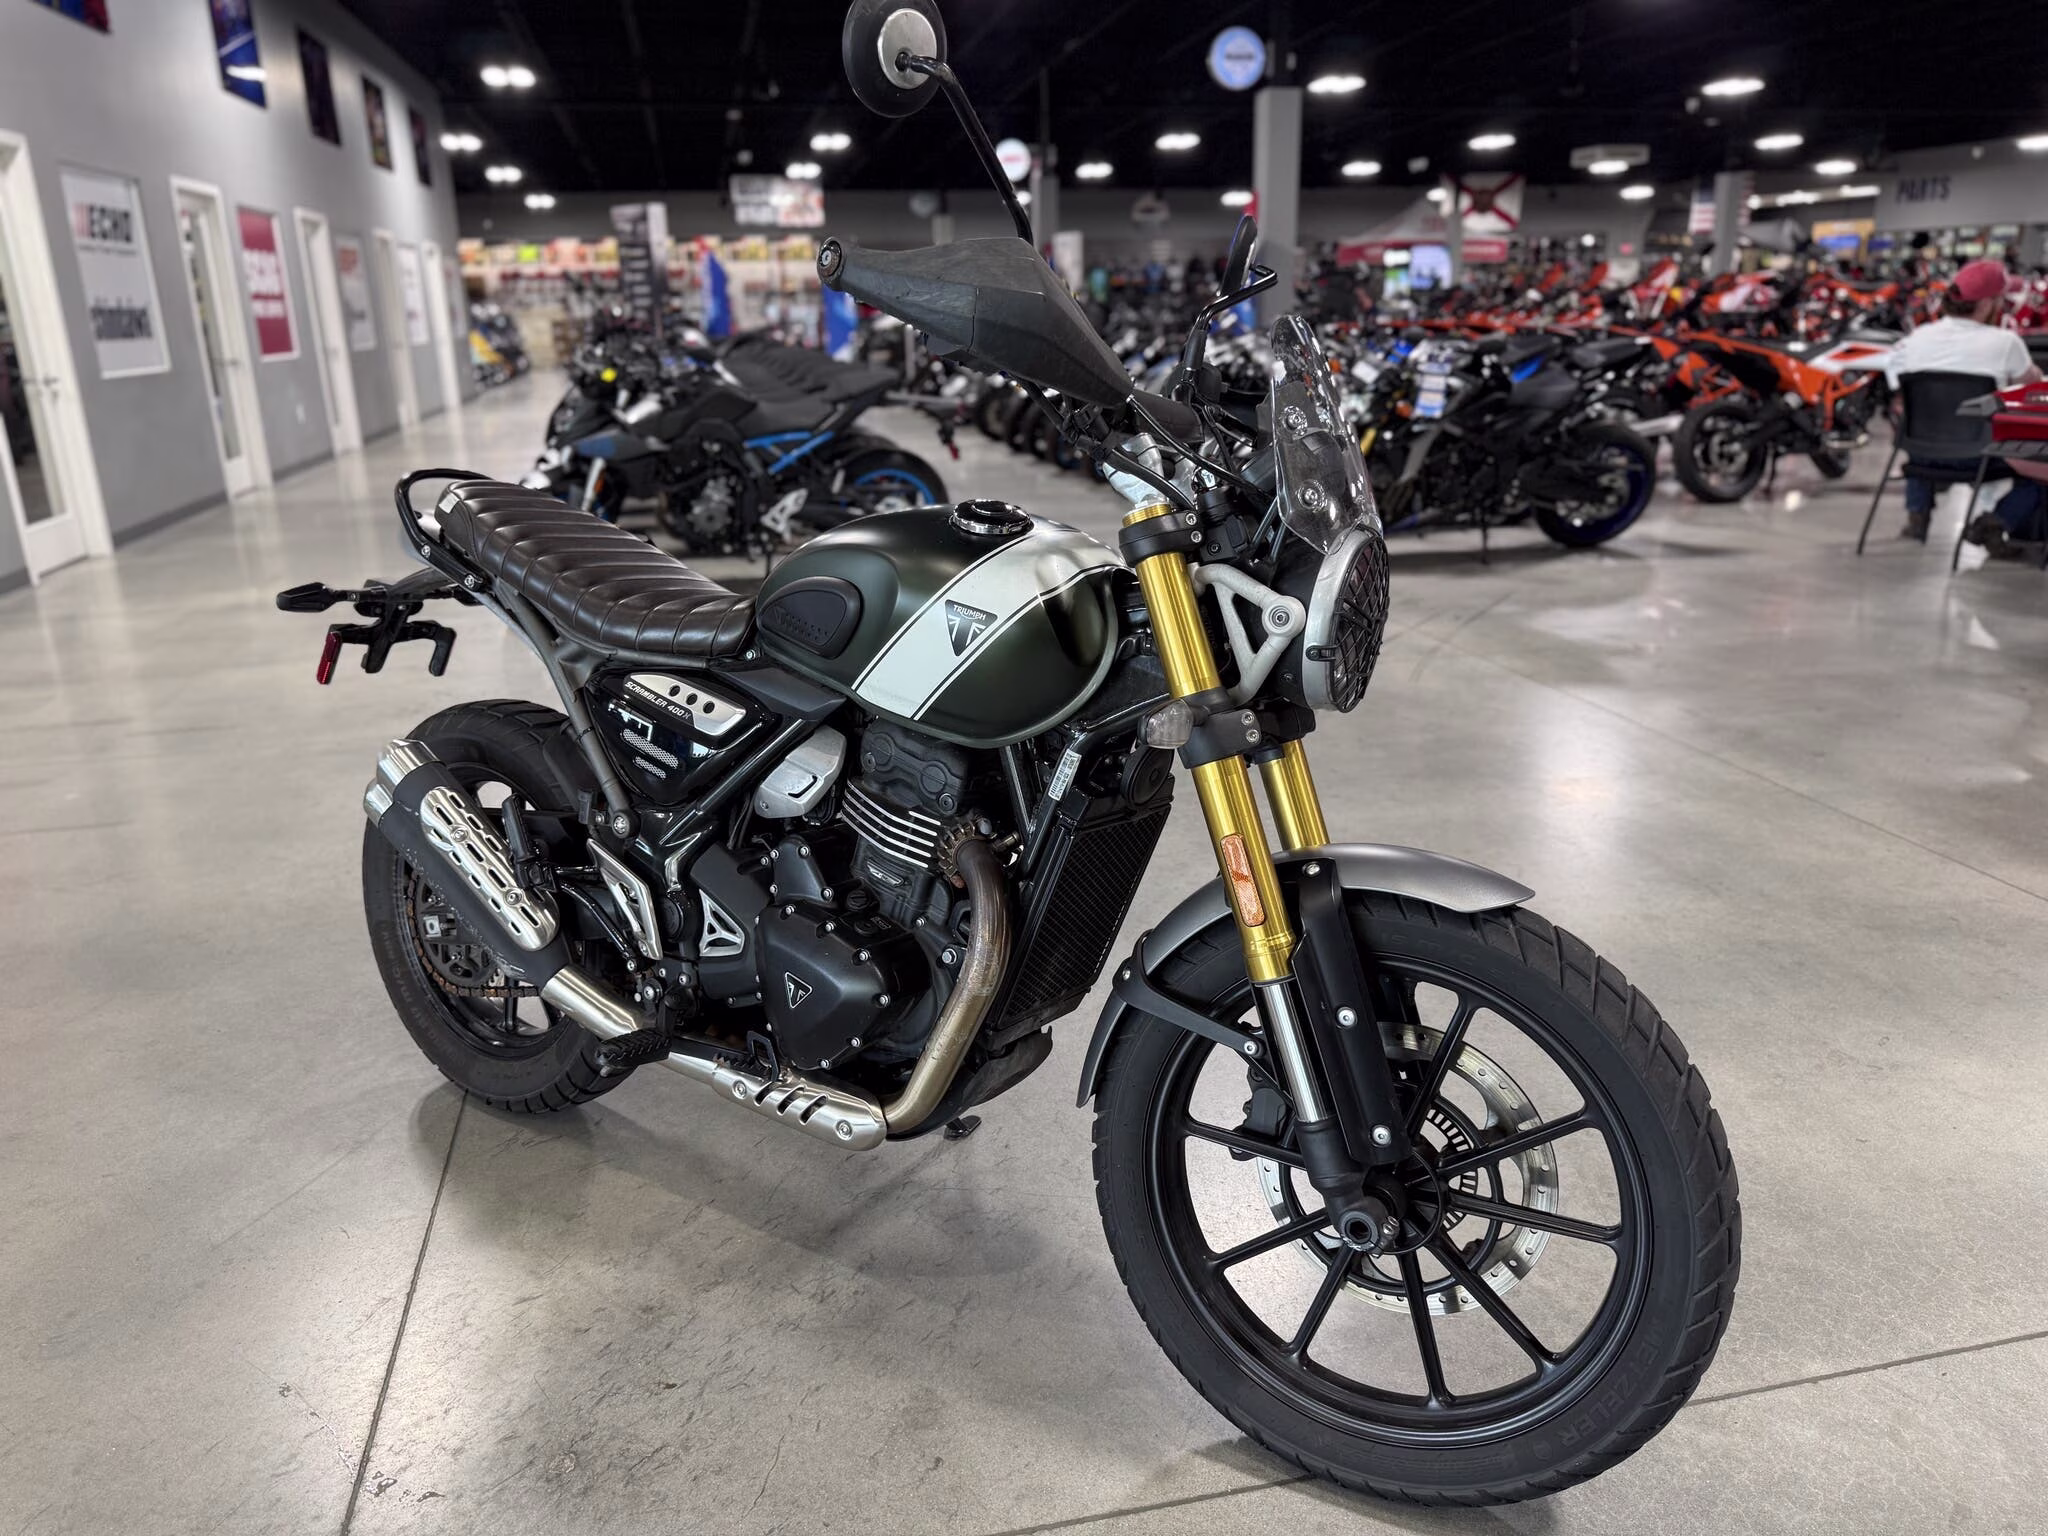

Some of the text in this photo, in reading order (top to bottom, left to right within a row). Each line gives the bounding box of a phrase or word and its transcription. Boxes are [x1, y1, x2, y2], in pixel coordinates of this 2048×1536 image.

[1896, 176, 1951, 203] PARTS
[953, 604, 987, 620] TRIUMPH
[624, 681, 668, 708] SCRAMBLER
